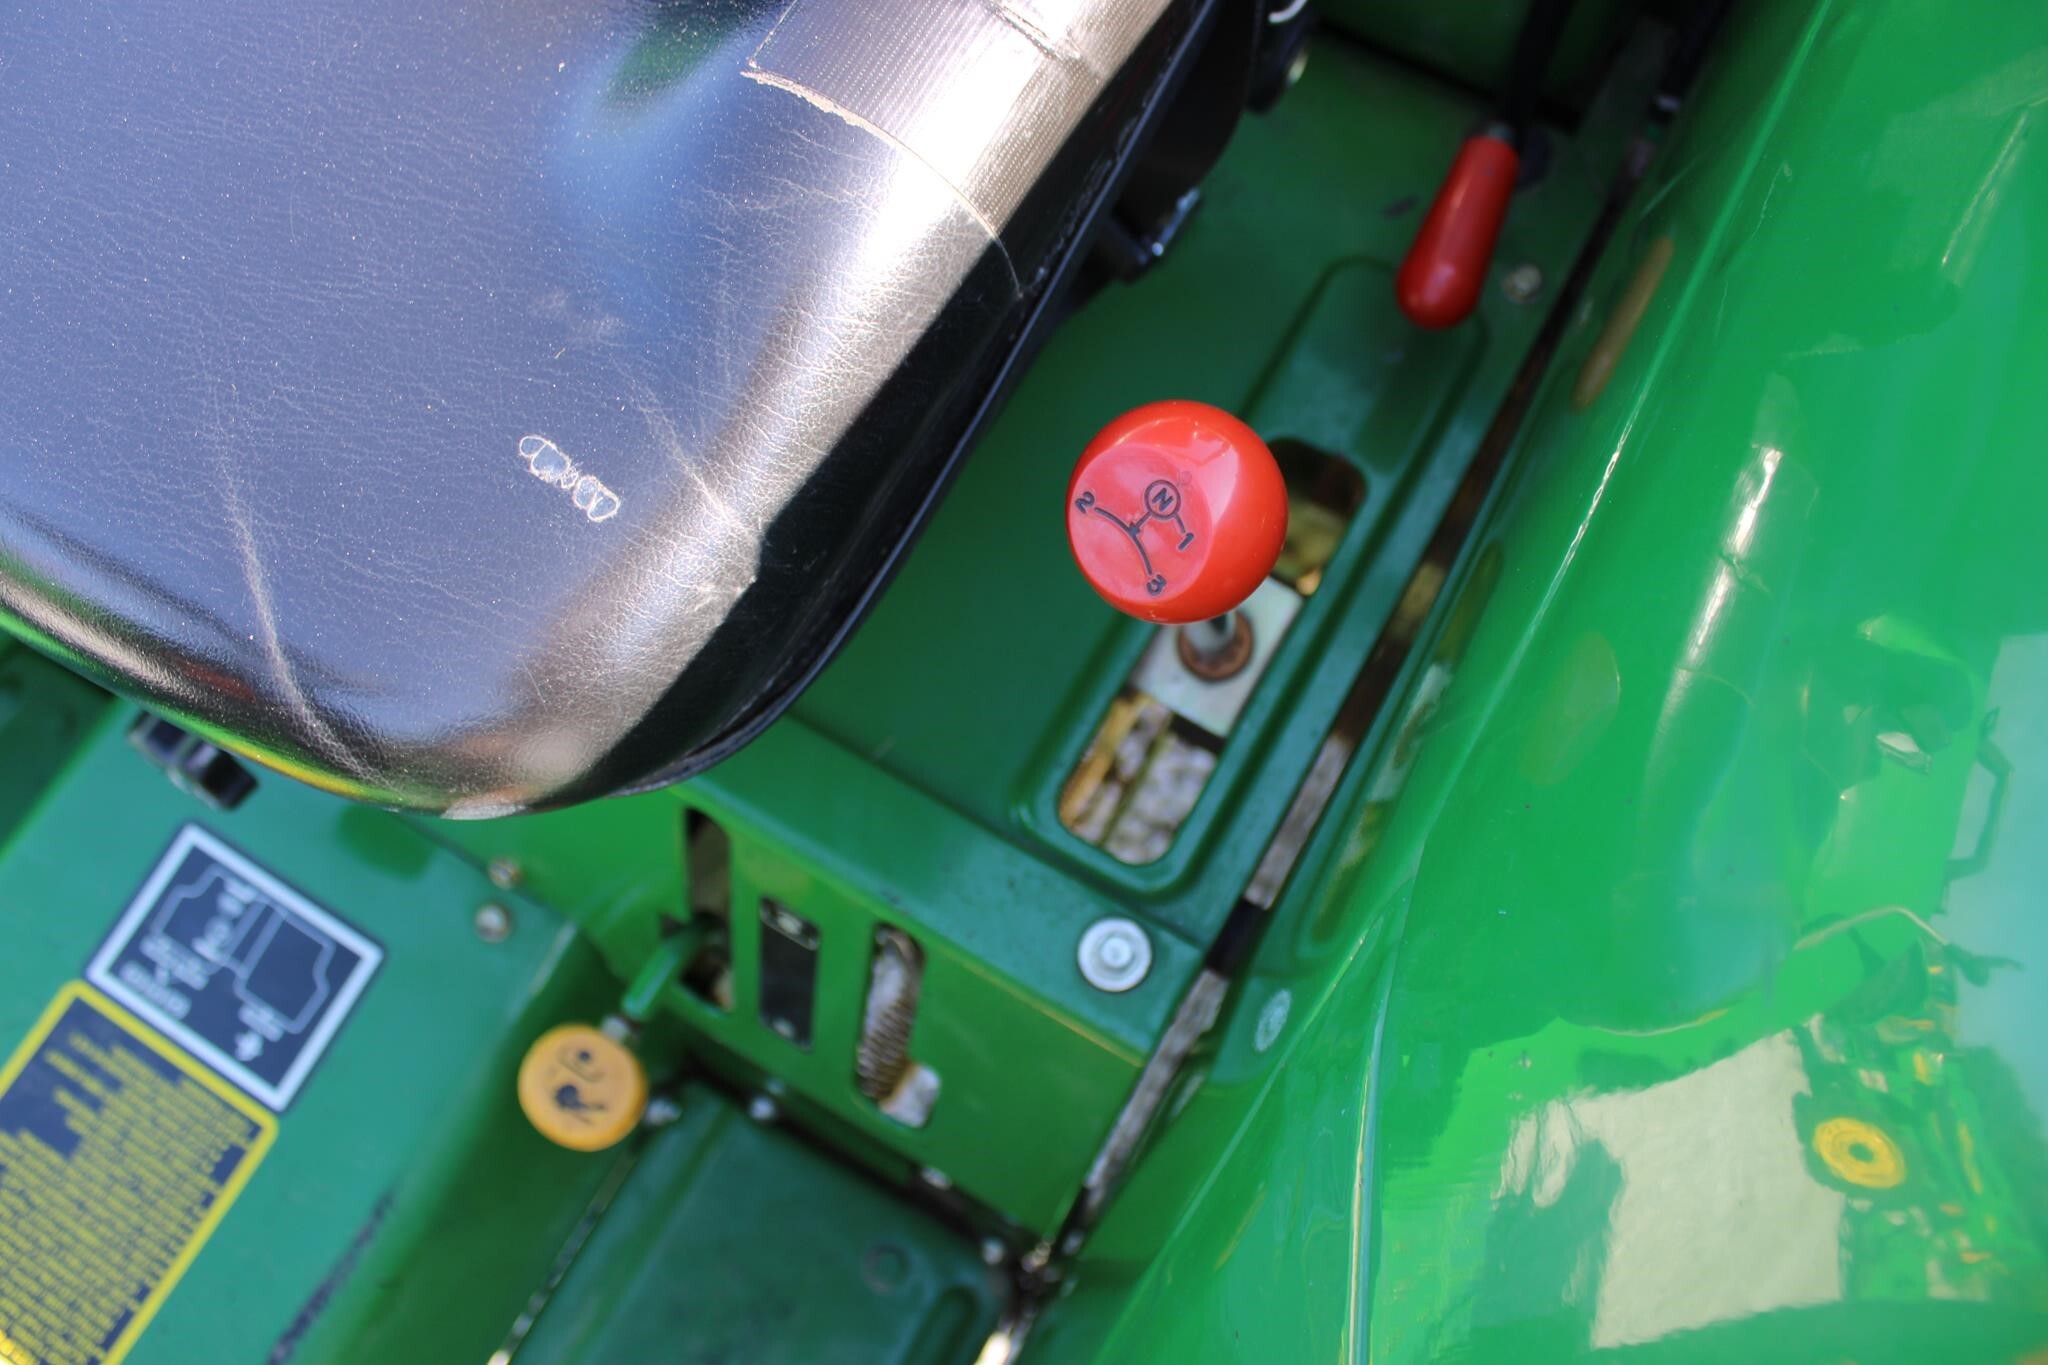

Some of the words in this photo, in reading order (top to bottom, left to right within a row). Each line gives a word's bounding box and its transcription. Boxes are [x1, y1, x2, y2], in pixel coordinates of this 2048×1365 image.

[1075, 491, 1095, 513] 2
[1153, 488, 1174, 511] N
[1178, 532, 1194, 550] 1
[1147, 574, 1166, 595] 3
